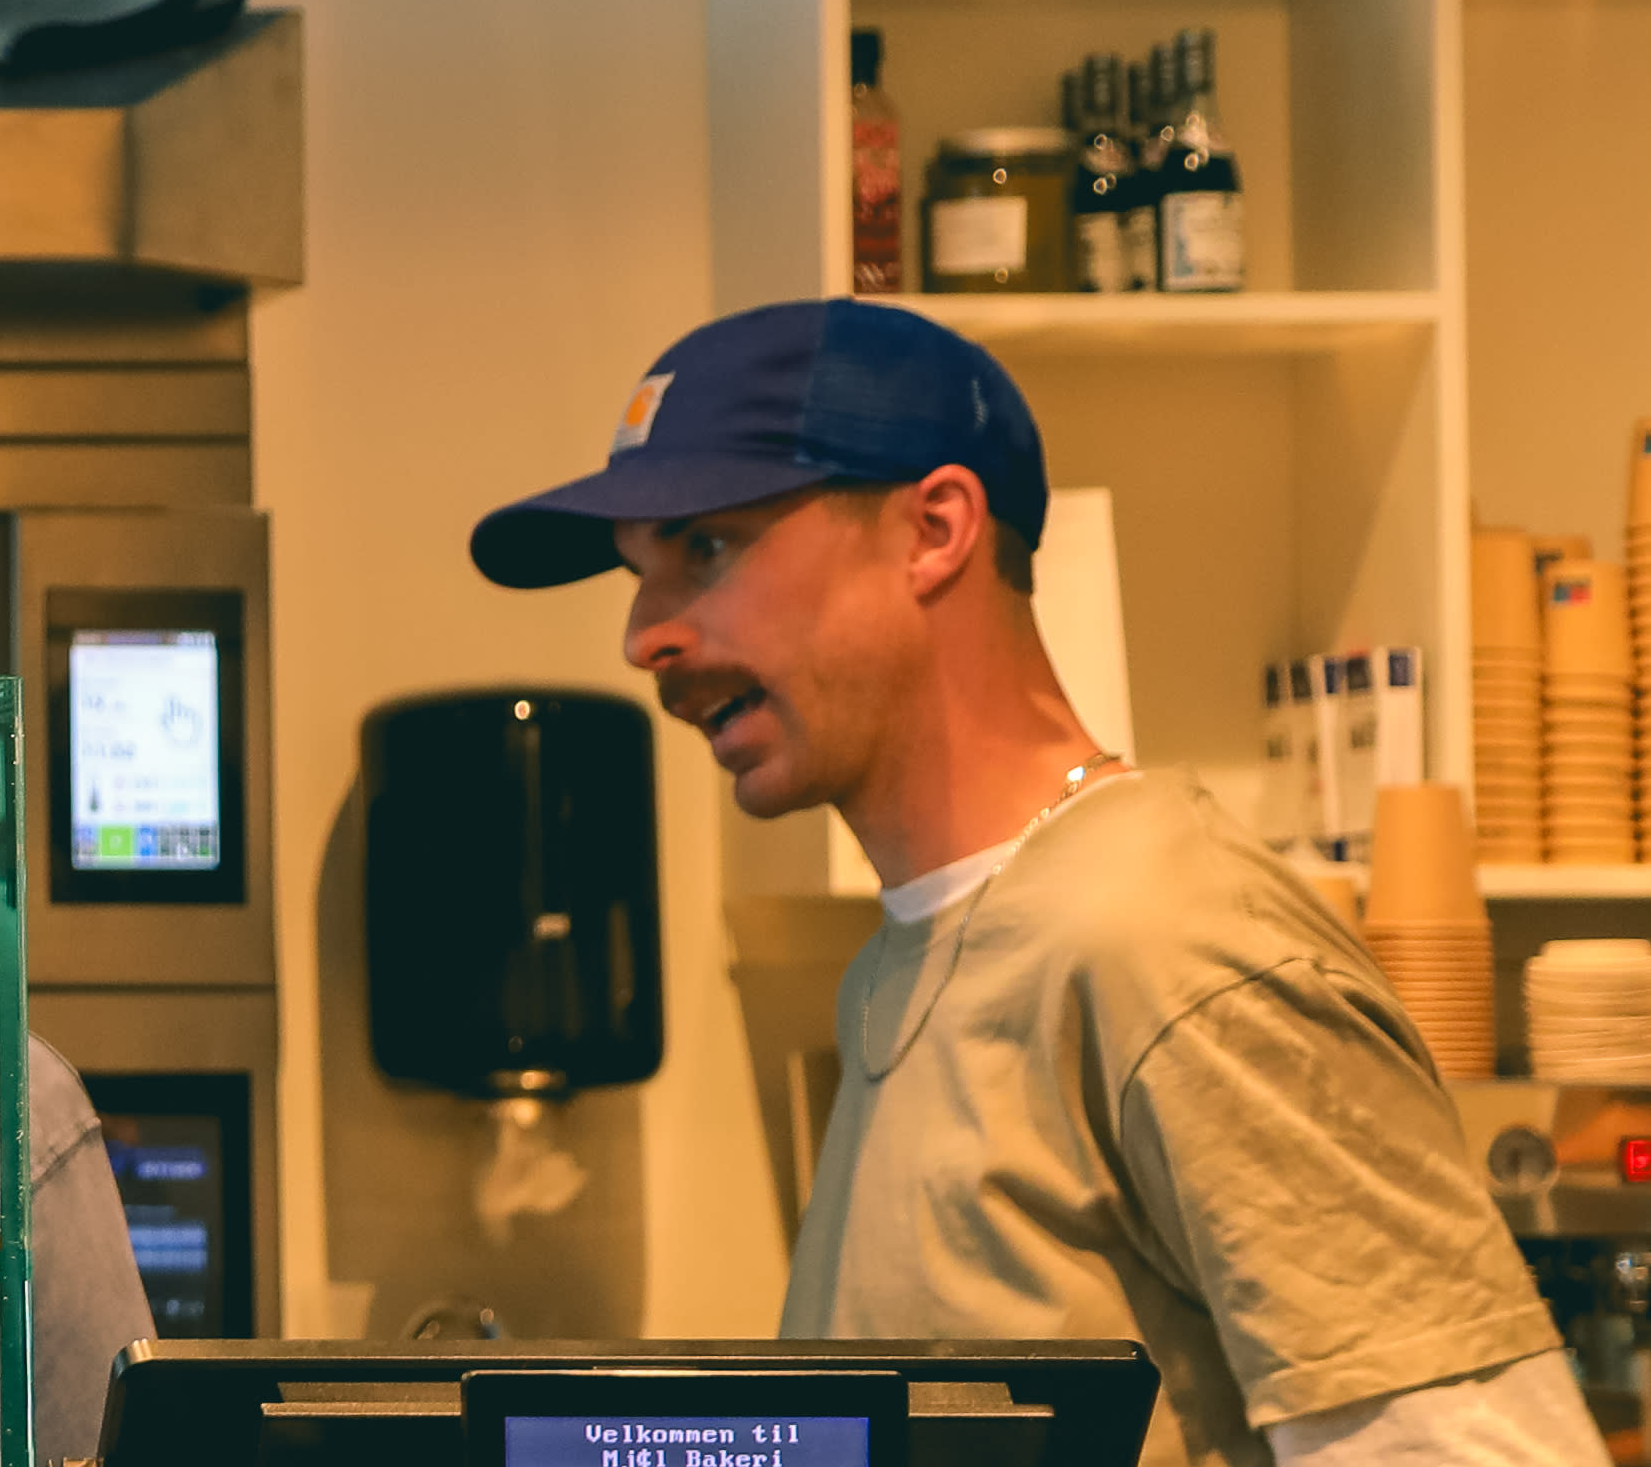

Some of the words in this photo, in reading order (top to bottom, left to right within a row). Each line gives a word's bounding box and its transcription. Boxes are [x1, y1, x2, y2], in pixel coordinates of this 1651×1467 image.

[585, 1424, 735, 1444] Velkommen
[752, 1424, 799, 1443] til
[685, 1449, 783, 1467] Bakeri
